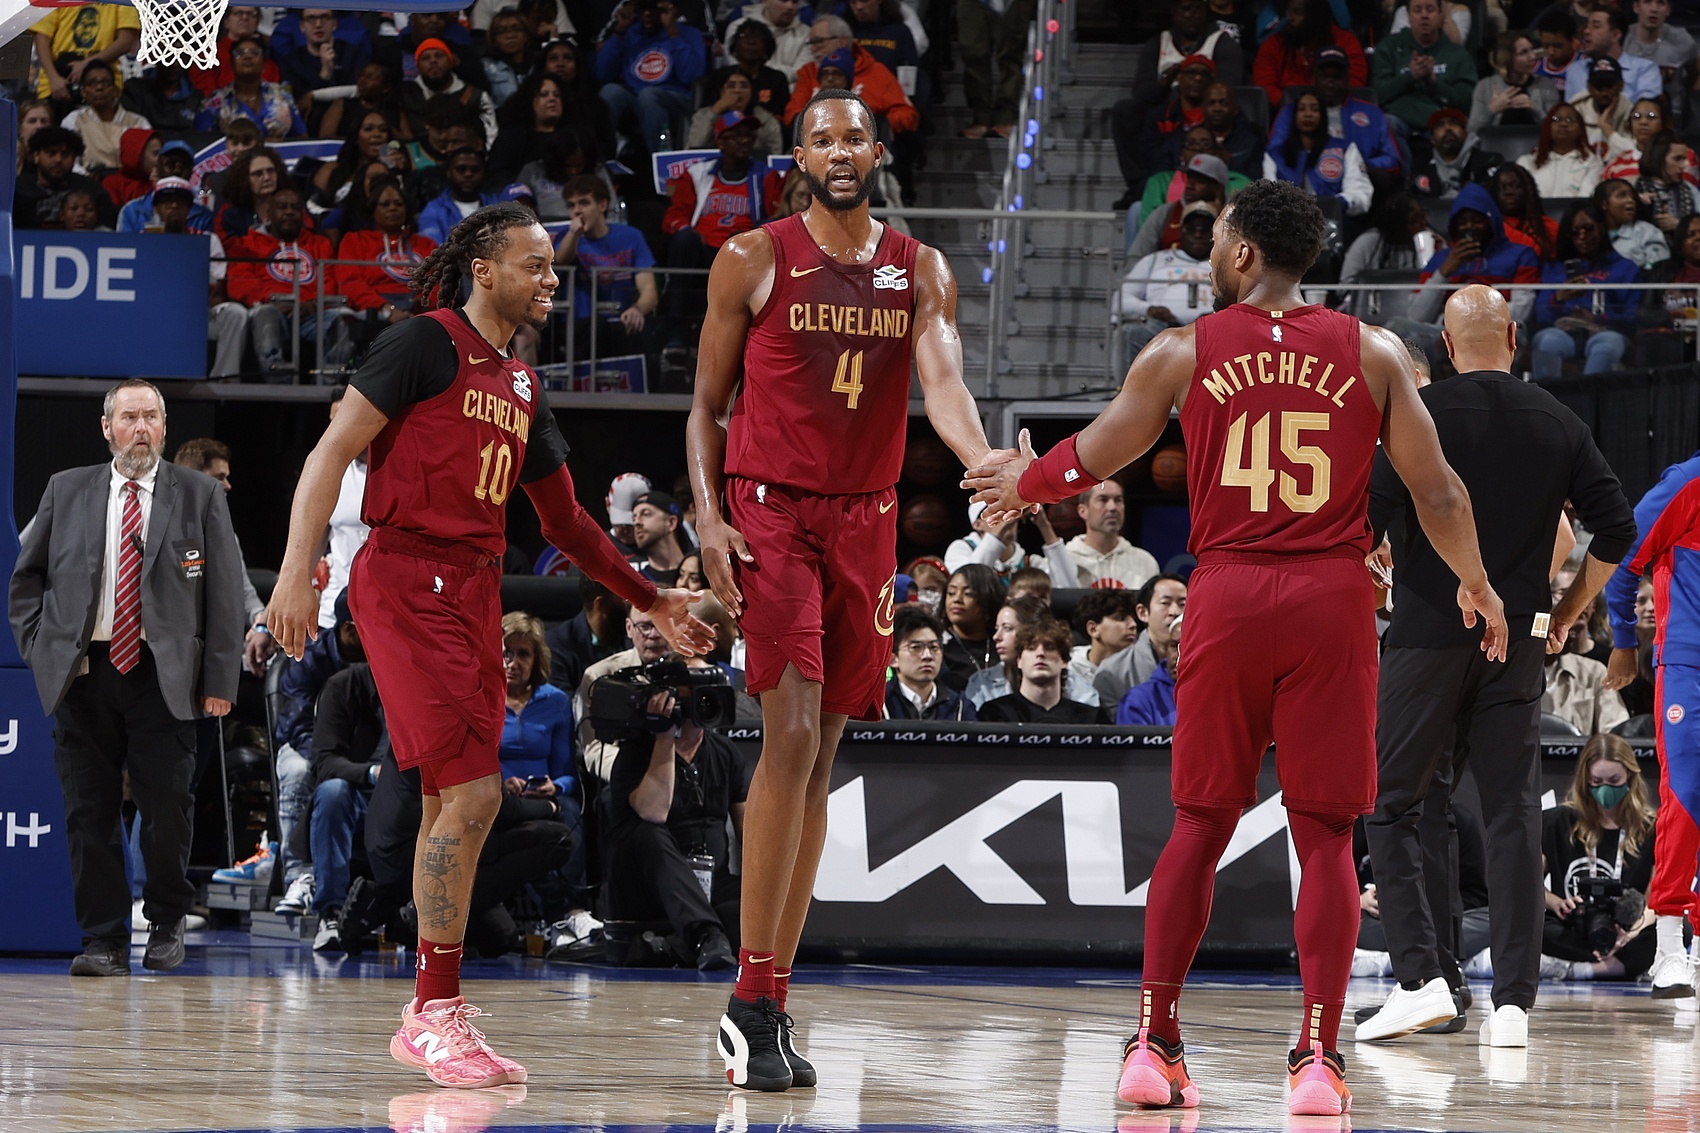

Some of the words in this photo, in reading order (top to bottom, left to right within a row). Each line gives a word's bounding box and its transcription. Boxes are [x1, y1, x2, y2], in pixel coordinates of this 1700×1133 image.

[717, 214, 735, 227] 2
[789, 303, 909, 338] CLEVELAND
[831, 348, 864, 410] 4
[1202, 352, 1357, 408] MITCHELL
[474, 440, 511, 506] 10
[1220, 411, 1331, 513] 45
